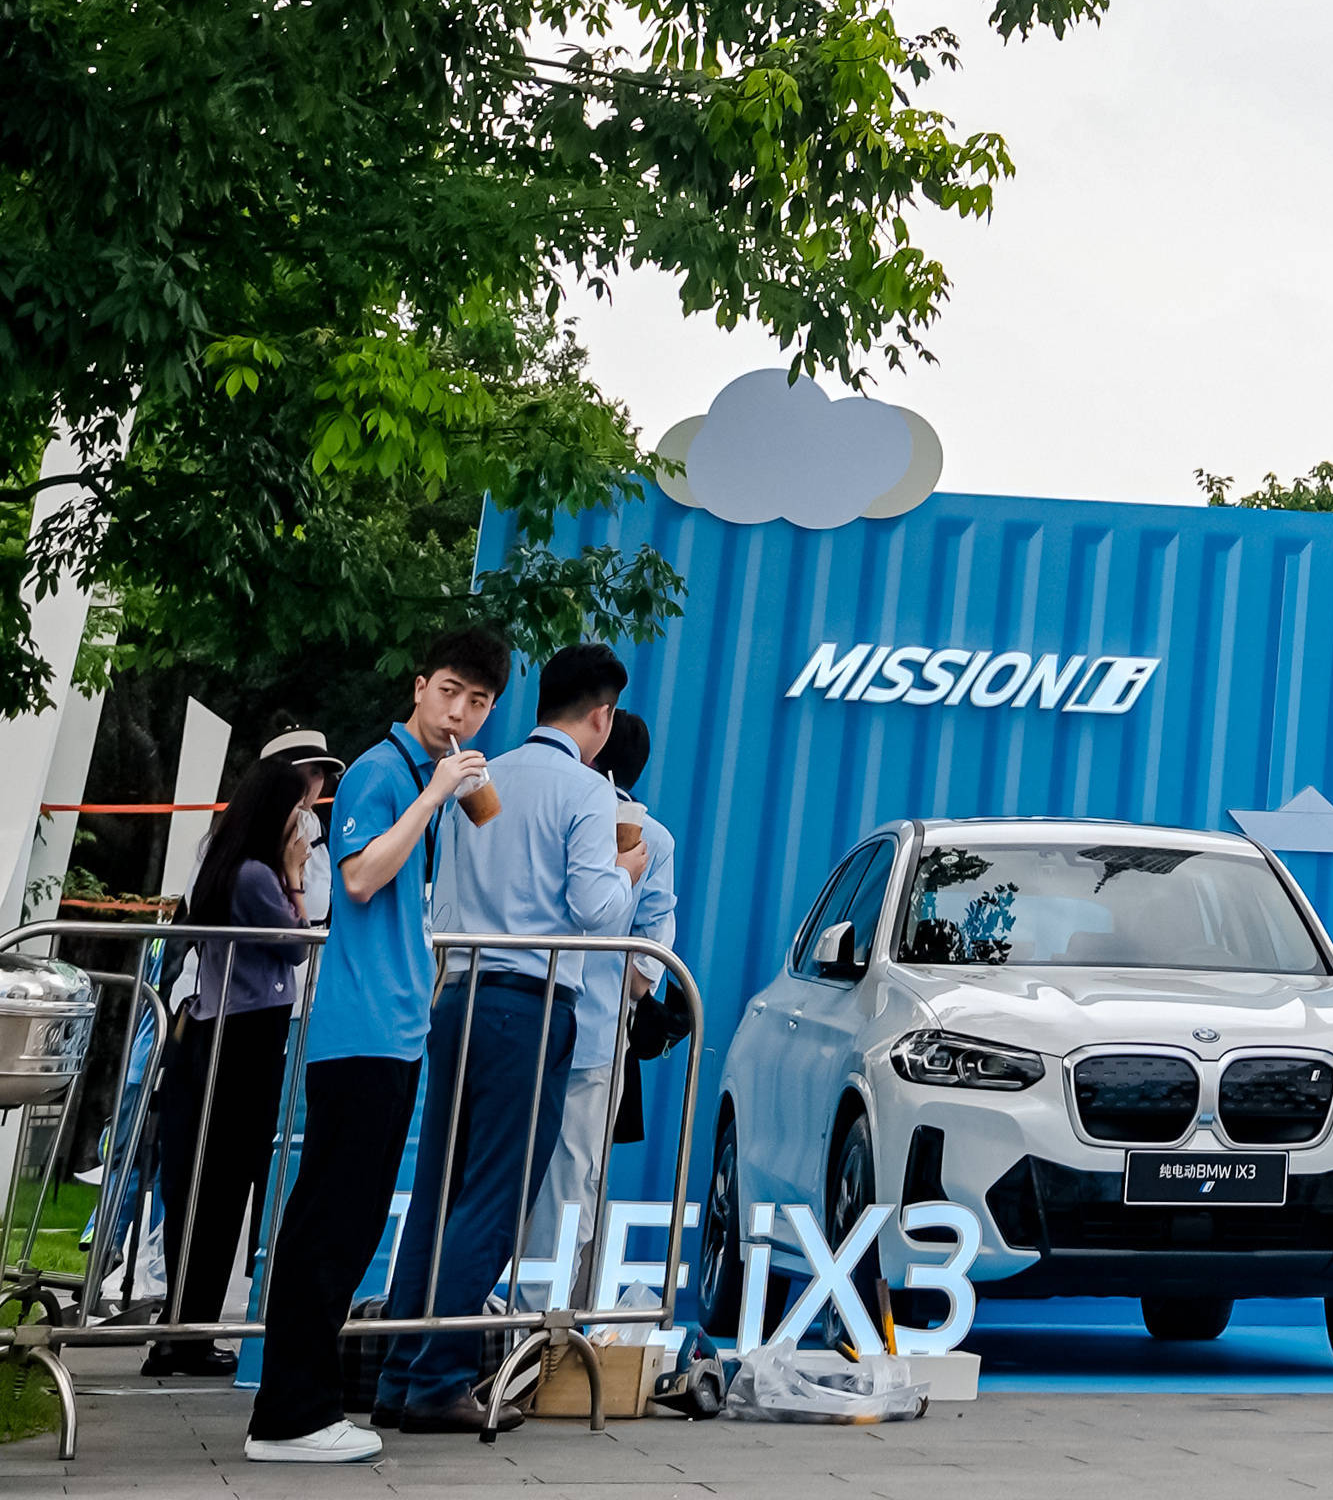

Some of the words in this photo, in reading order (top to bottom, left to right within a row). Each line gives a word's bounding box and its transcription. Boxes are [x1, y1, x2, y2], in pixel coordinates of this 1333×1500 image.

[785, 643, 1089, 710] MISSION
[1159, 1163, 1231, 1179] 纯电动BMW
[738, 1201, 983, 1356] iX3
